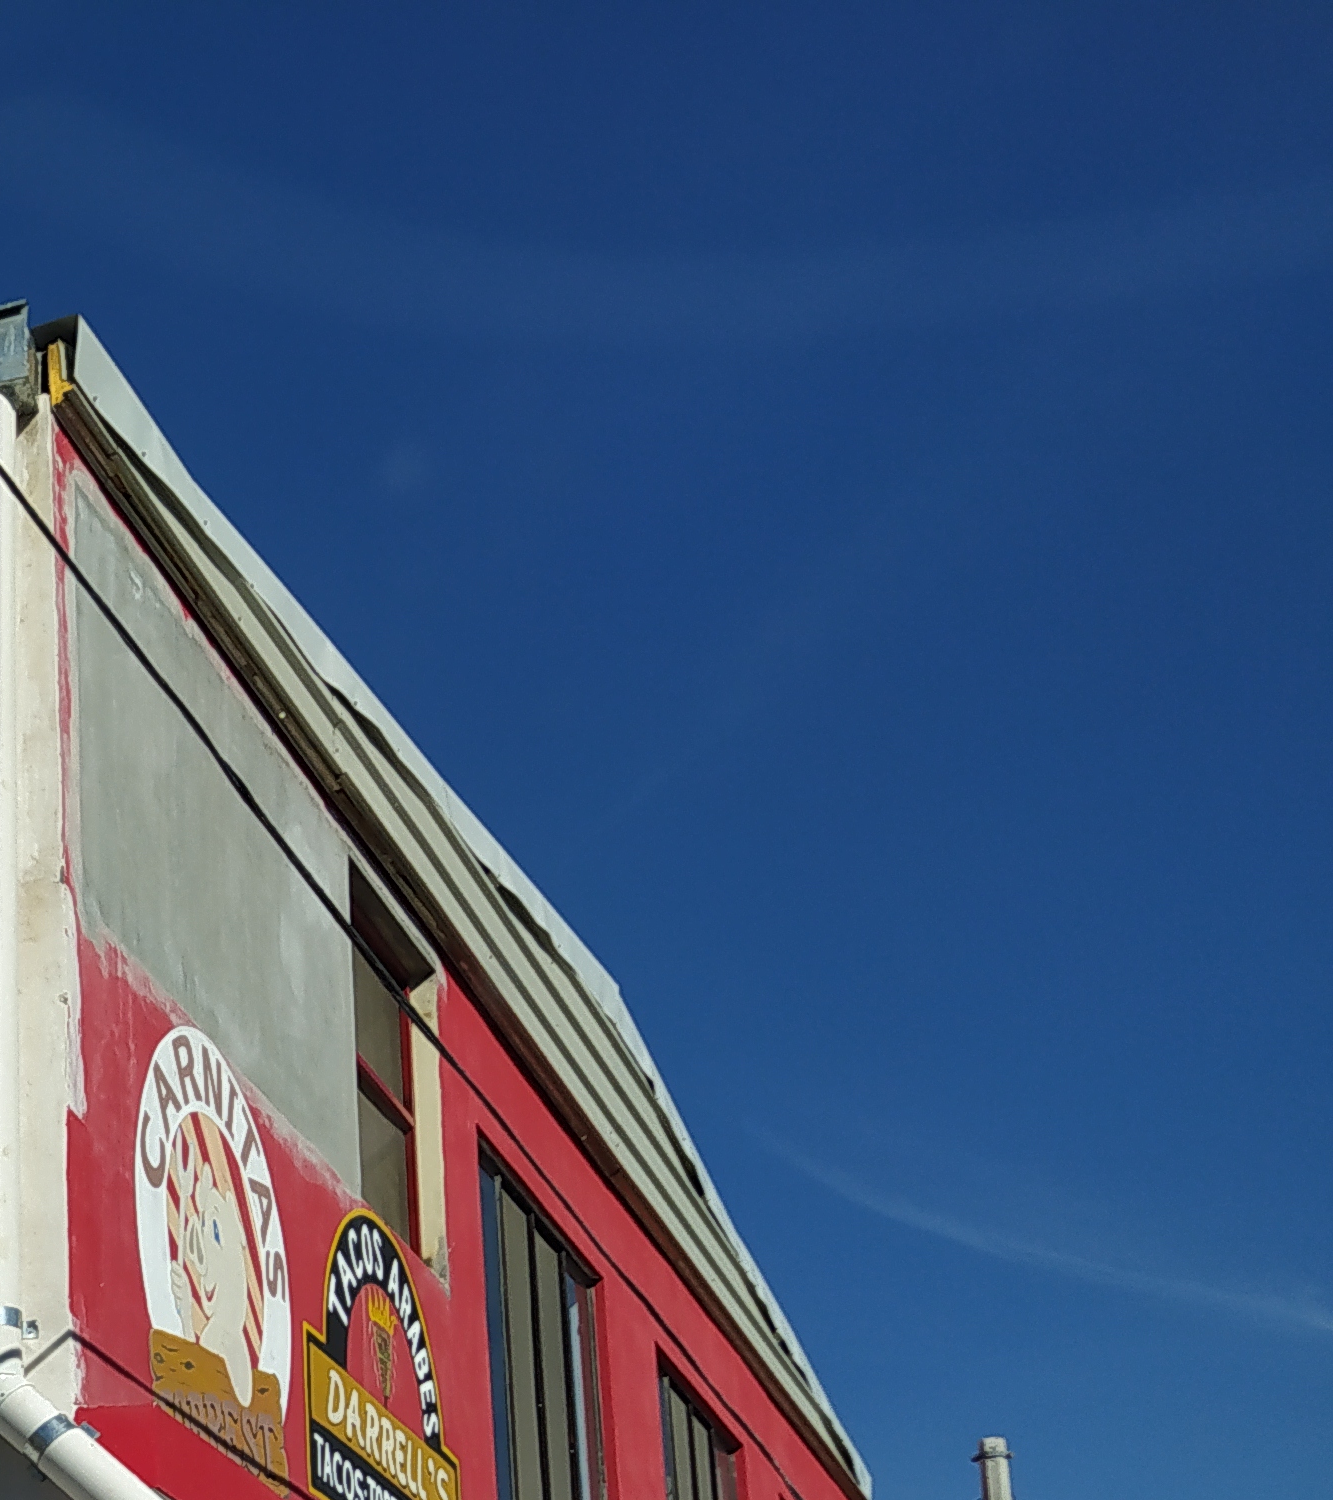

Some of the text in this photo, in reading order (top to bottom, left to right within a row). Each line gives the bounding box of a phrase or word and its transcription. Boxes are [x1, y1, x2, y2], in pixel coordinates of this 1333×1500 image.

[140, 1034, 286, 1303] CARNITAS
[328, 1223, 439, 1438] TACOS ARABES
